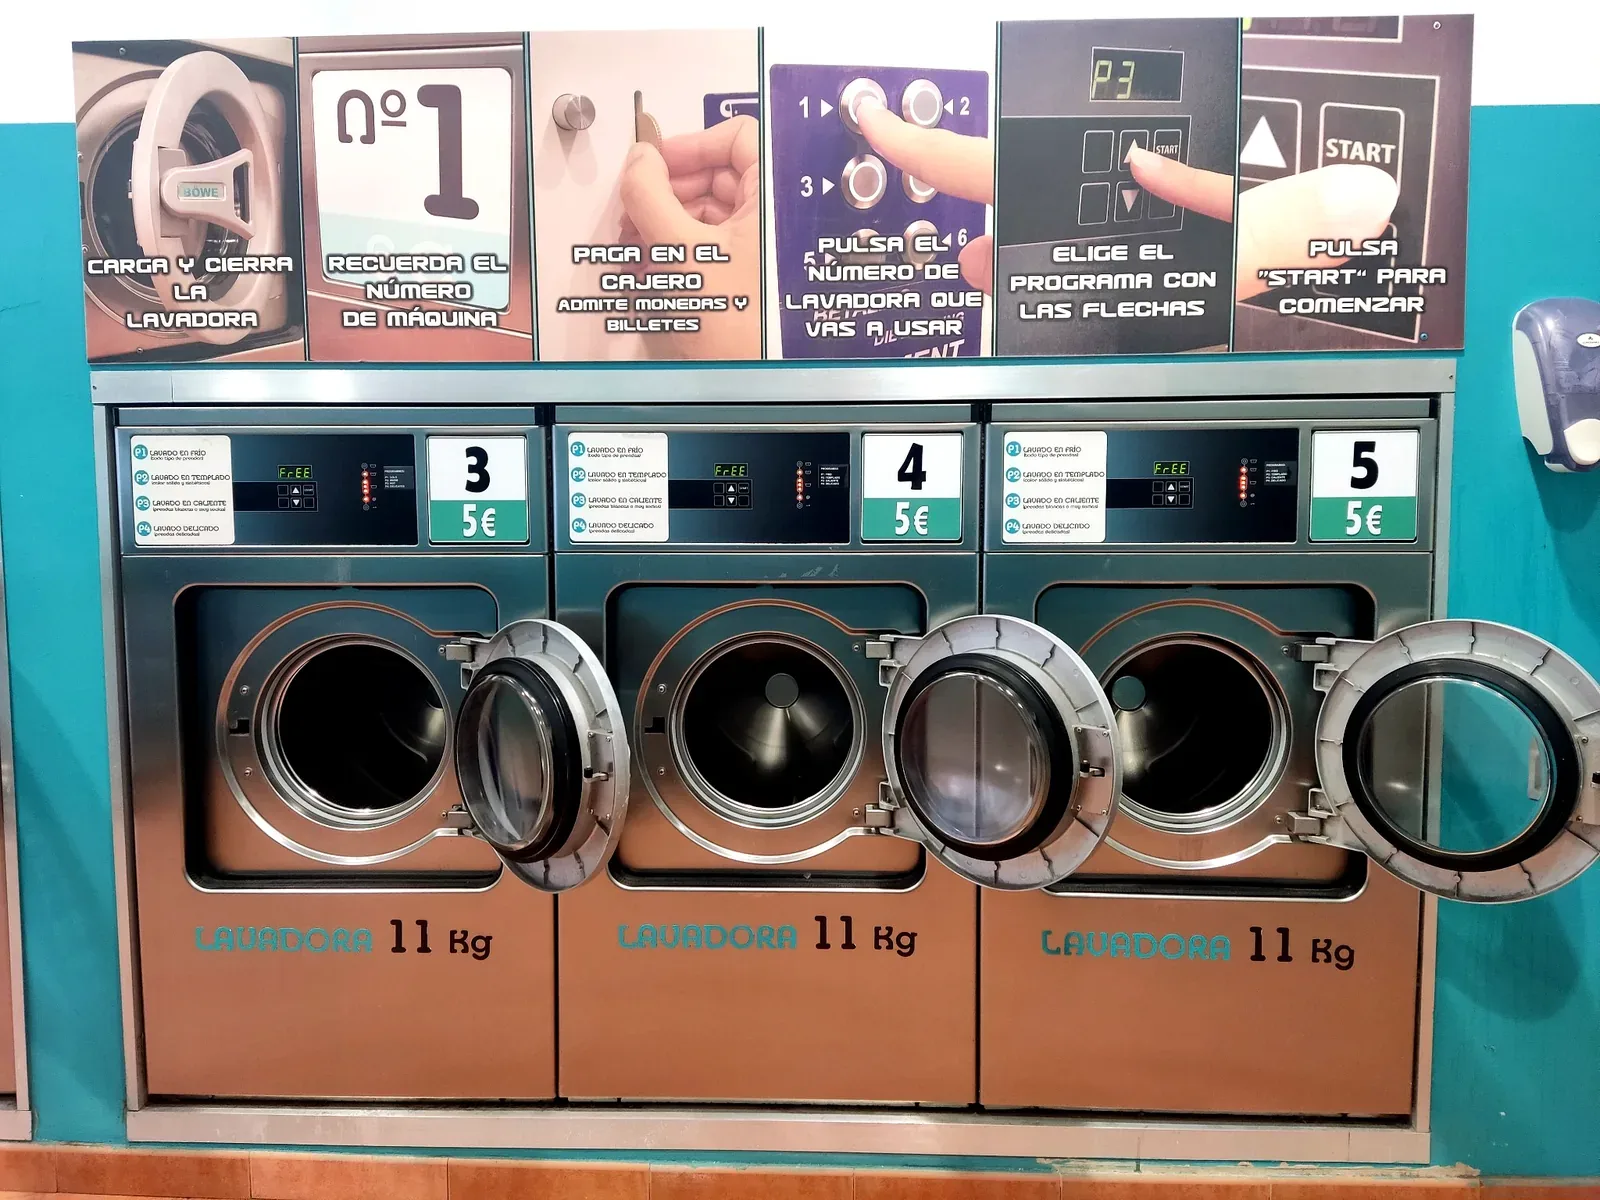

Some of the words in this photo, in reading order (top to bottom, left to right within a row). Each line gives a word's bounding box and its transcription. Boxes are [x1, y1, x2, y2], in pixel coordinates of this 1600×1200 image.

[800, 97, 810, 118] 1
[959, 97, 970, 116] 2
[1156, 144, 1179, 156] START
[1326, 138, 1396, 164] START
[183, 184, 219, 198] BÖWE
[801, 177, 813, 198] 3
[818, 236, 903, 253] PULSA
[915, 236, 949, 251] EL
[957, 229, 968, 246] 6
[573, 246, 640, 262] PAGA
[651, 246, 685, 262] EN
[695, 245, 728, 261] EL
[1053, 246, 1127, 262] ELIGE
[1140, 244, 1173, 261] EL
[1309, 240, 1398, 257] PULSA
[88, 259, 168, 274] CARGA
[178, 258, 195, 273] Y
[205, 257, 293, 273] CIERRA
[328, 256, 464, 272] RECUERDA
[474, 256, 507, 271] EL
[808, 261, 914, 281] NÚMERO
[925, 264, 959, 280] DE
[601, 274, 702, 290] CAJERO
[1010, 273, 1152, 291] PROGRAMA
[1164, 272, 1217, 289] CON
[1377, 268, 1447, 285] PARA
[174, 285, 207, 300] LA
[366, 279, 472, 299] NÚMERO
[558, 298, 628, 311] ADMITE
[636, 297, 727, 310] MONEDAS
[734, 297, 748, 310] Y
[785, 292, 920, 310] LAVADORA
[931, 292, 982, 308] QUE
[1020, 302, 1072, 319] LAS
[1083, 300, 1205, 318] FLECHAS
[1280, 297, 1424, 314] COMENZAR
[126, 312, 258, 328] LAVADORA
[344, 312, 376, 327] DE
[387, 306, 497, 328] MÁQUINA
[607, 318, 699, 332] BILLETES
[806, 321, 856, 337] VAS
[867, 321, 884, 336] A
[895, 320, 963, 336] USAR
[190, 448, 206, 456] FRÍO
[628, 445, 644, 453] FRÍO
[1065, 445, 1082, 453] FRÍO
[465, 446, 491, 493] 3
[897, 442, 927, 490] 4
[1350, 441, 1379, 489] 5
[462, 503, 496, 538] 5€
[895, 501, 929, 536] 5€
[1346, 500, 1383, 536] 5€
[195, 925, 373, 954] LAVADORA
[390, 919, 430, 954] 11
[448, 930, 493, 961] Kg
[618, 922, 798, 951] LAVADORA
[813, 915, 857, 951] 11
[873, 926, 918, 957] Kg
[1041, 929, 1232, 961] LAVADORA
[1249, 926, 1294, 963] 11
[1311, 938, 1356, 971] Kg
